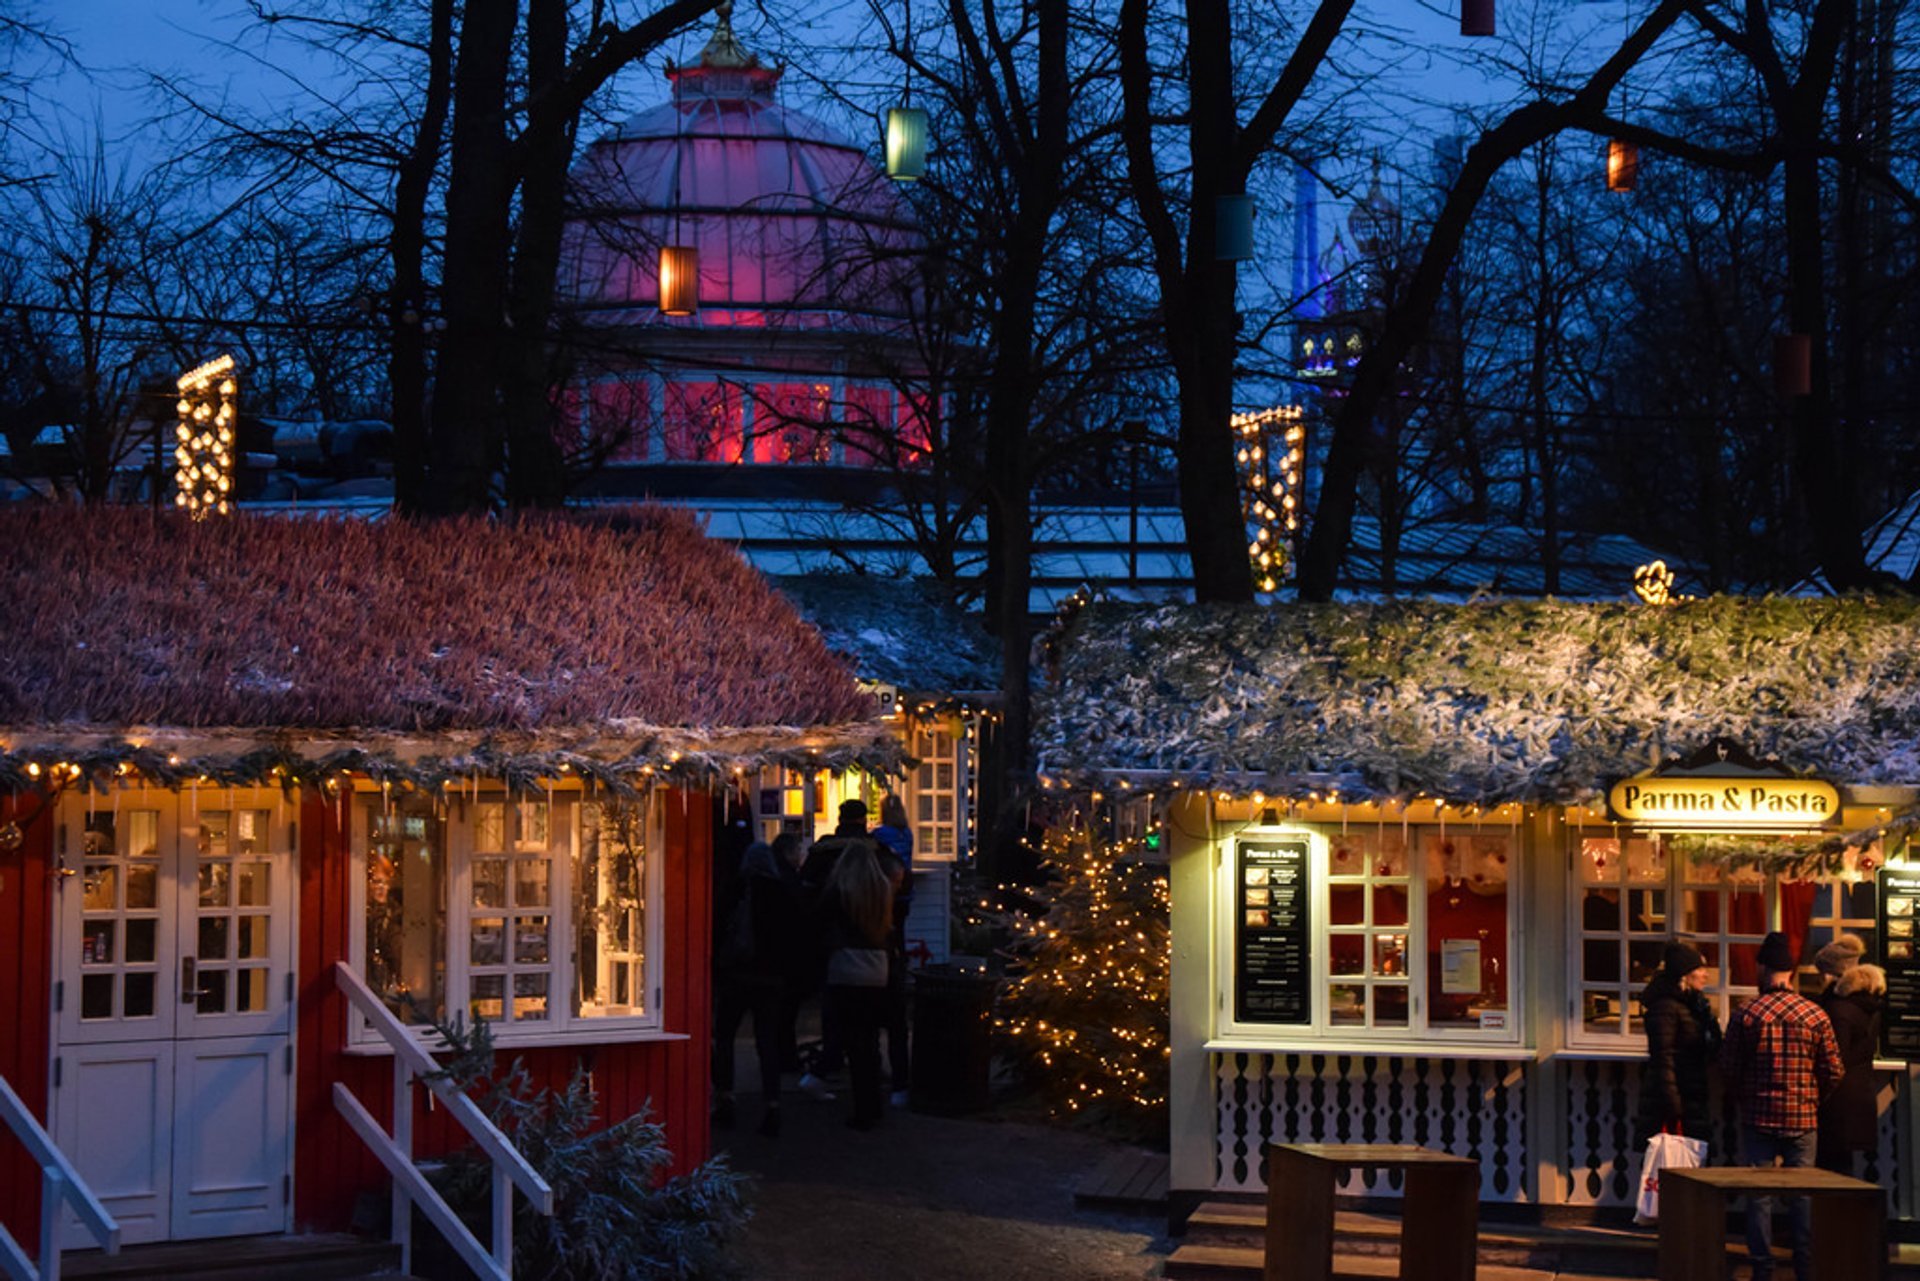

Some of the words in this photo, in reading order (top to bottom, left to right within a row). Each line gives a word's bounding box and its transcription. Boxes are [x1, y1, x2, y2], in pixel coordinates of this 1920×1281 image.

[1624, 786, 1714, 811] Parma
[1722, 786, 1742, 812] &
[1751, 787, 1828, 813] Pasta
